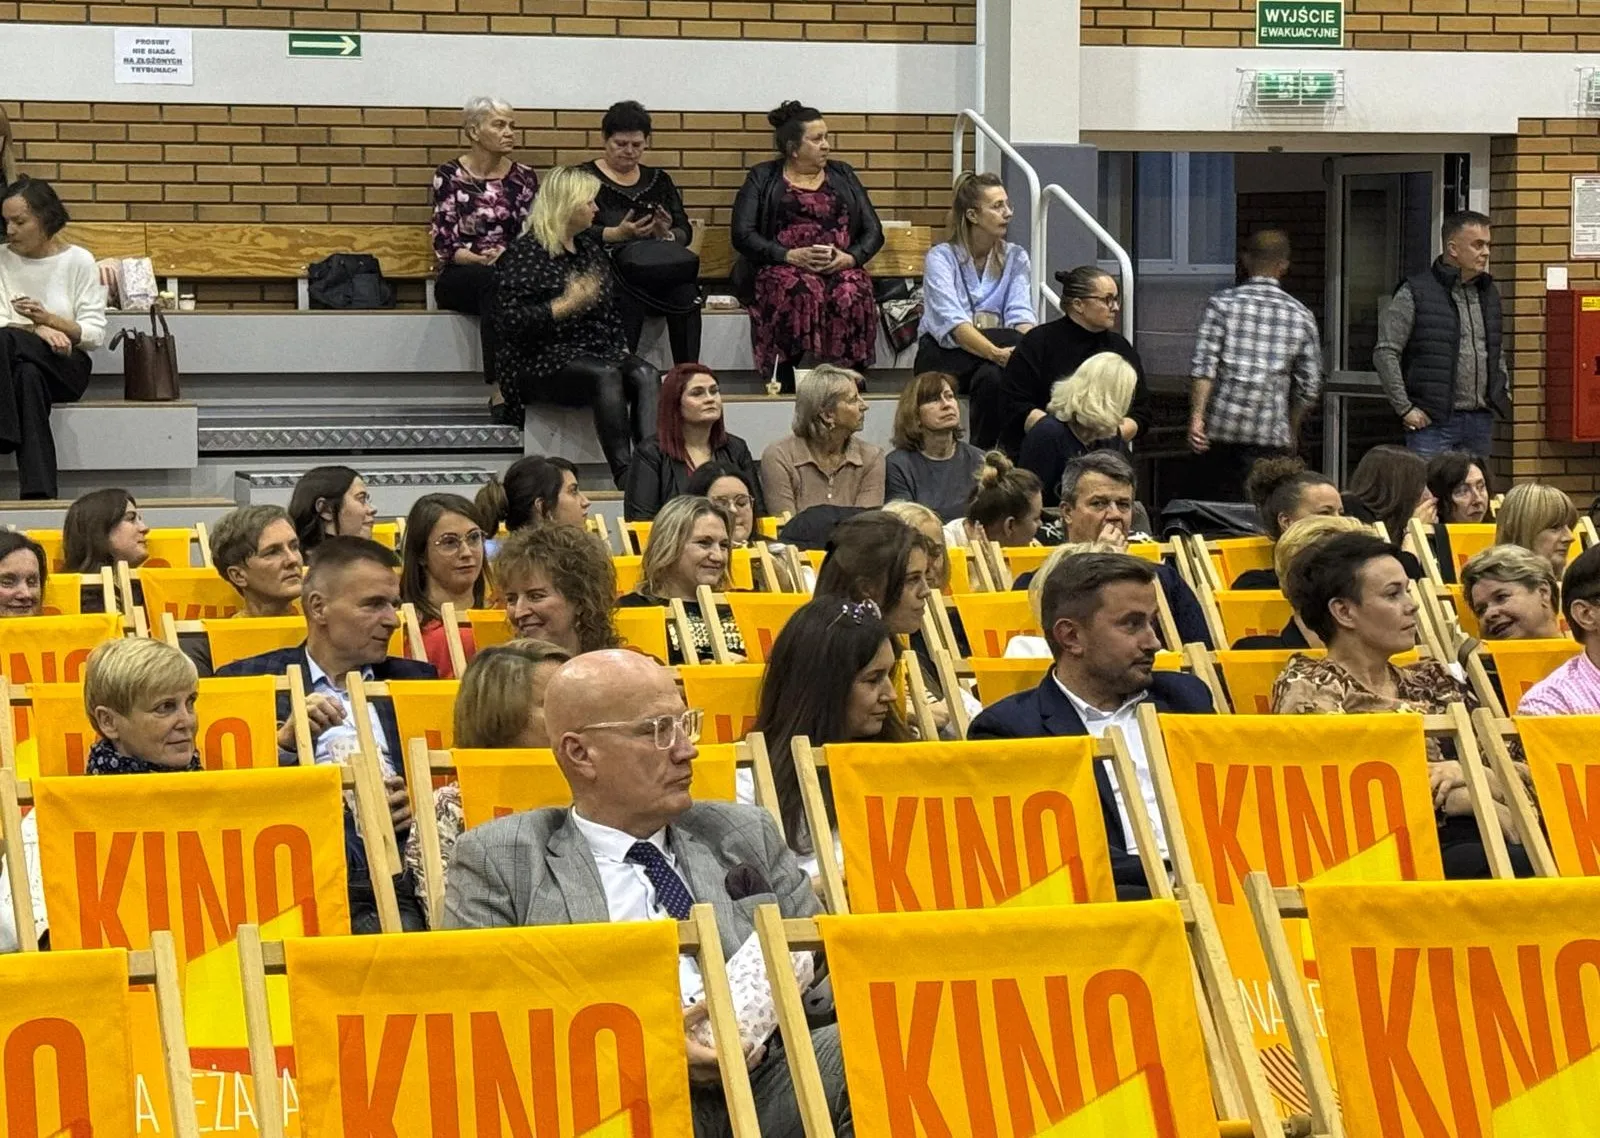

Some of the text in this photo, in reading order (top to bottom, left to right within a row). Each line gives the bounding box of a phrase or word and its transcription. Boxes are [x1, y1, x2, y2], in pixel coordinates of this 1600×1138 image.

[1260, 26, 1340, 38] EWAKUACYJNE
[1264, 5, 1336, 24] WYJŚCIE
[73, 823, 320, 962] KINO
[864, 790, 1091, 912] KINO
[1195, 760, 1417, 905] KINO
[337, 1002, 654, 1138] KINO
[869, 968, 1178, 1138] KINO
